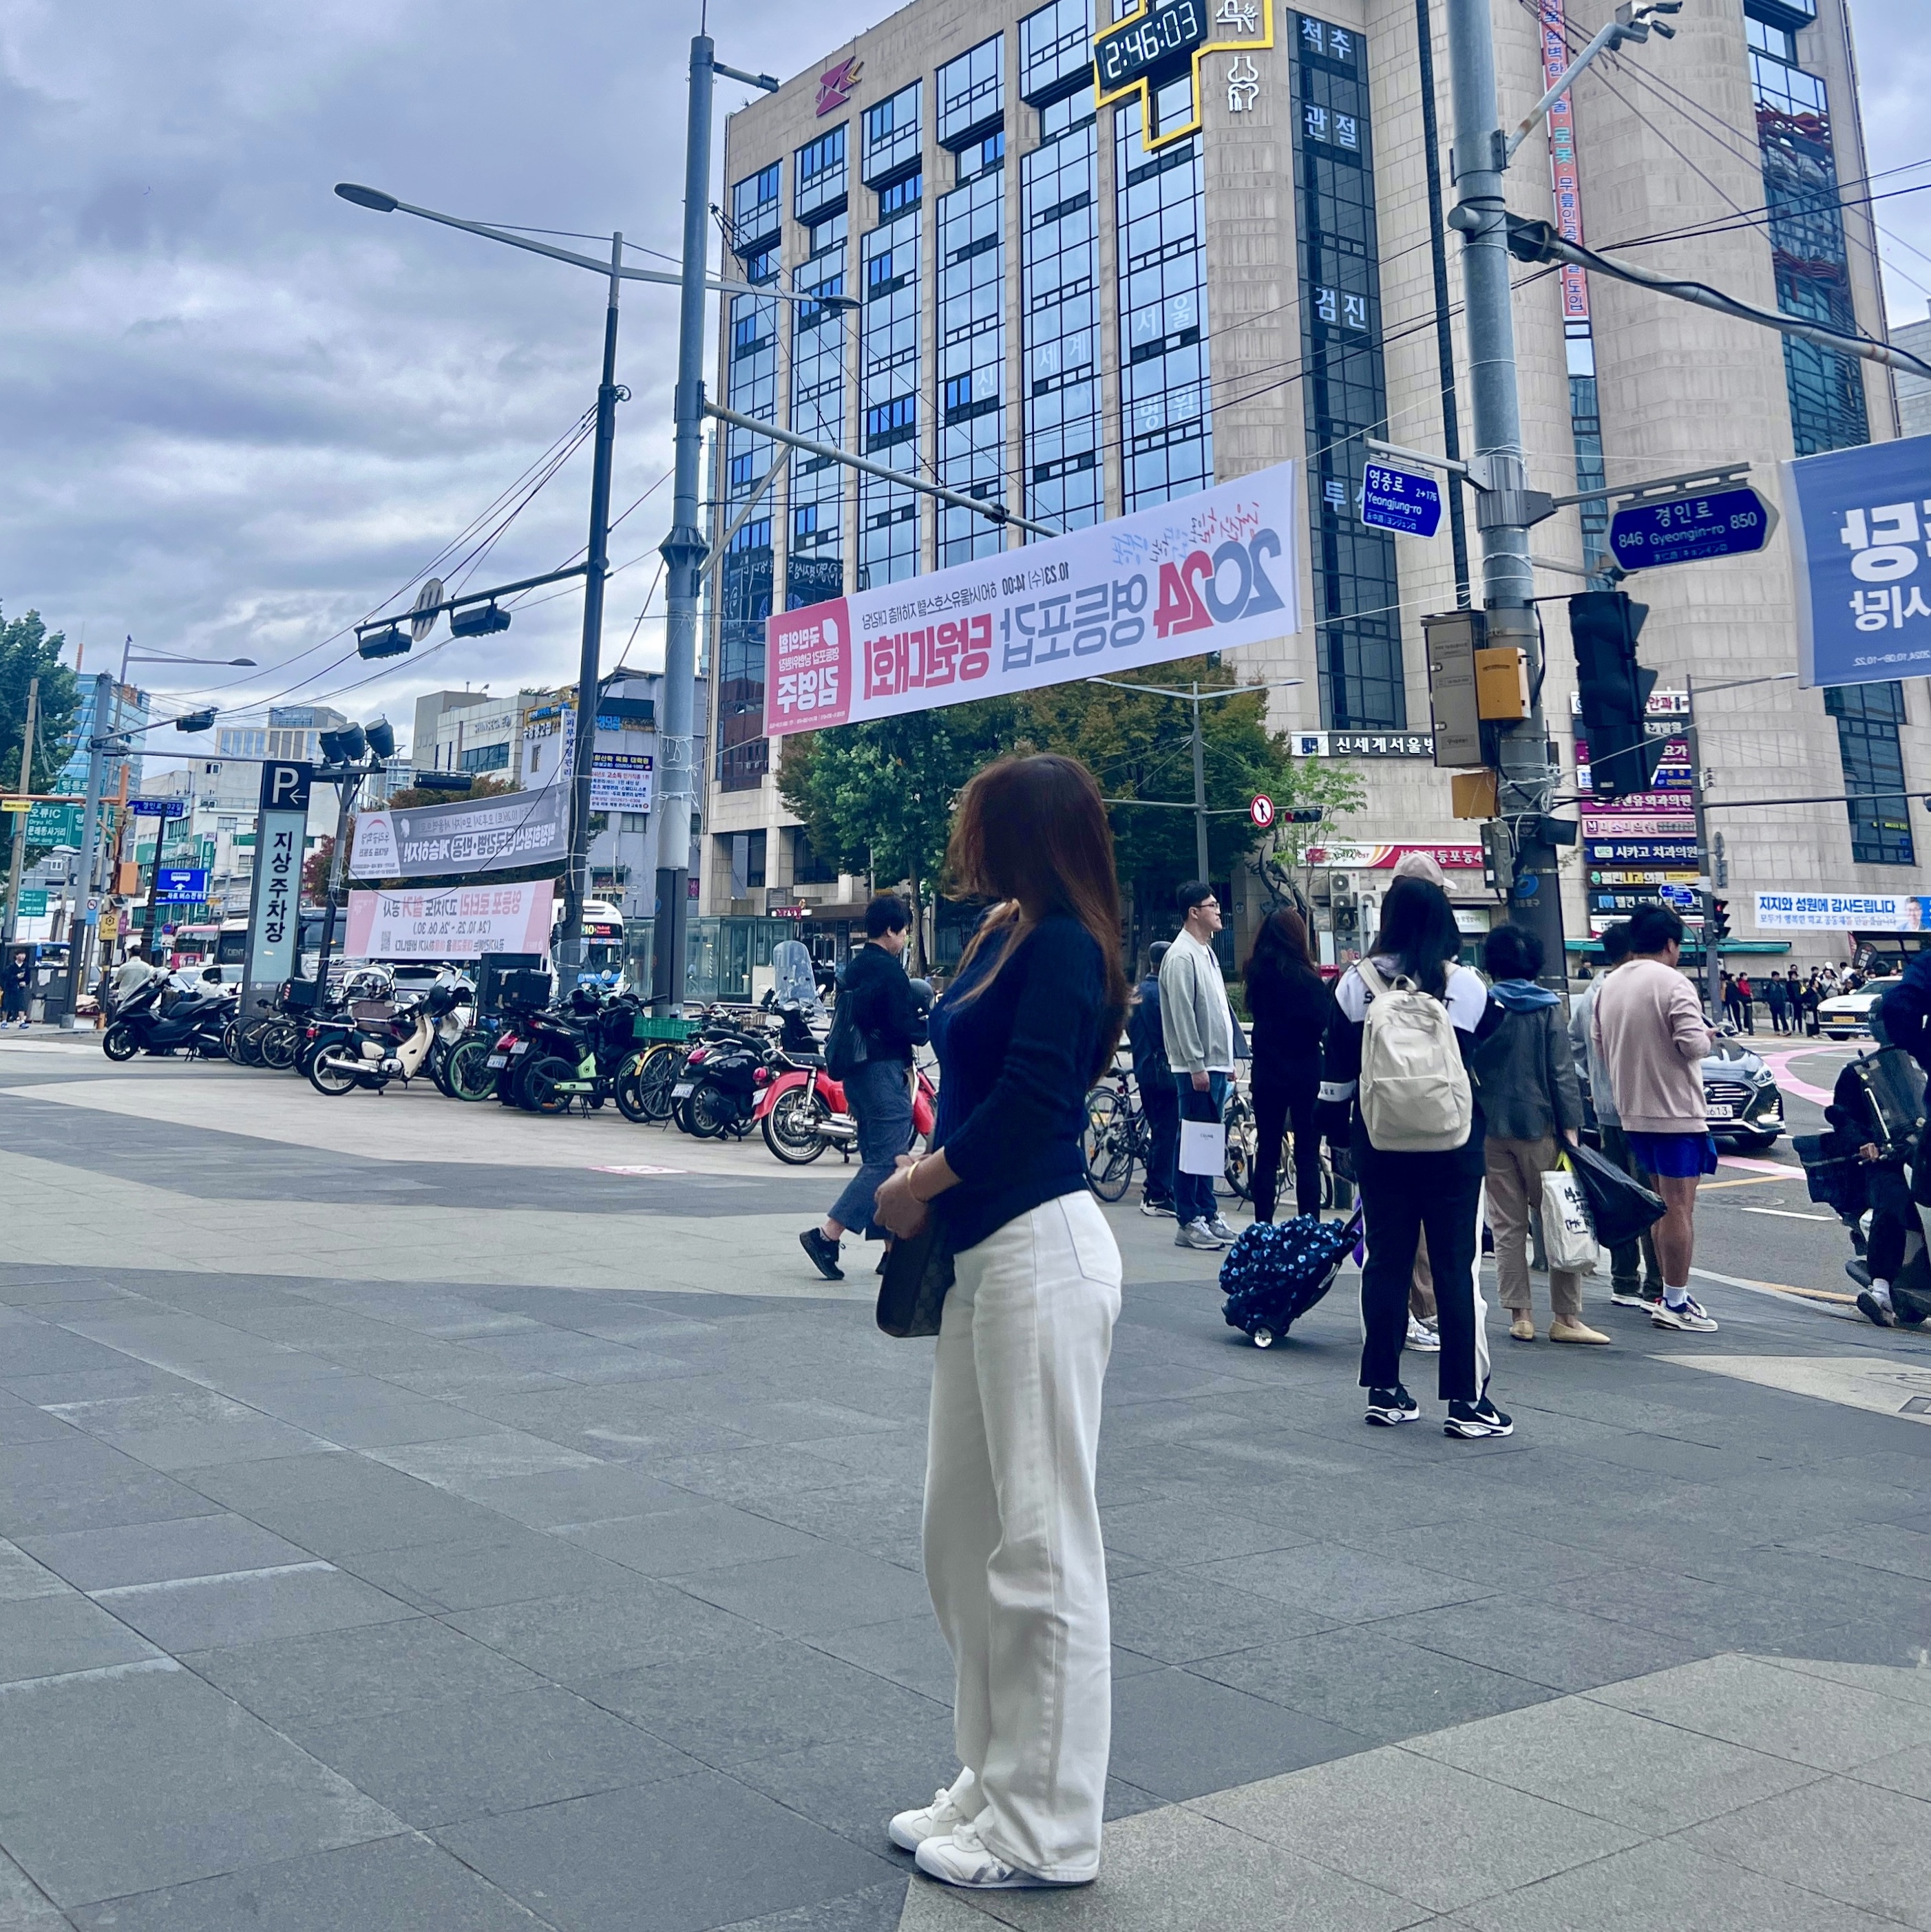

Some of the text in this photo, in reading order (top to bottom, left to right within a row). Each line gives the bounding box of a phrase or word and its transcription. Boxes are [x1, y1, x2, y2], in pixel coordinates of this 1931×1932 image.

[1301, 17, 1352, 60] 척추
[1304, 104, 1357, 149] 관절
[1554, 126, 1574, 166] 로봇
[1567, 278, 1584, 312] 도입
[1315, 287, 1367, 329] 검진
[1040, 332, 1088, 373] 세계
[1137, 294, 1191, 337] 서울
[1139, 388, 1194, 431] 병원
[1369, 469, 1405, 493] 영중로
[1367, 491, 1422, 515] Yeongjung-ro
[1655, 501, 1714, 527] 경인로
[1618, 511, 1758, 549] 846 Gyeongin-ro 850
[271, 766, 299, 804] P
[29, 808, 61, 819] 오류IC
[1616, 845, 1649, 858] 시카고
[1652, 845, 1698, 858] 치과의원
[264, 831, 293, 944] 지상주차장
[1759, 896, 1896, 914] 지지와 성원에 감사드립니다
